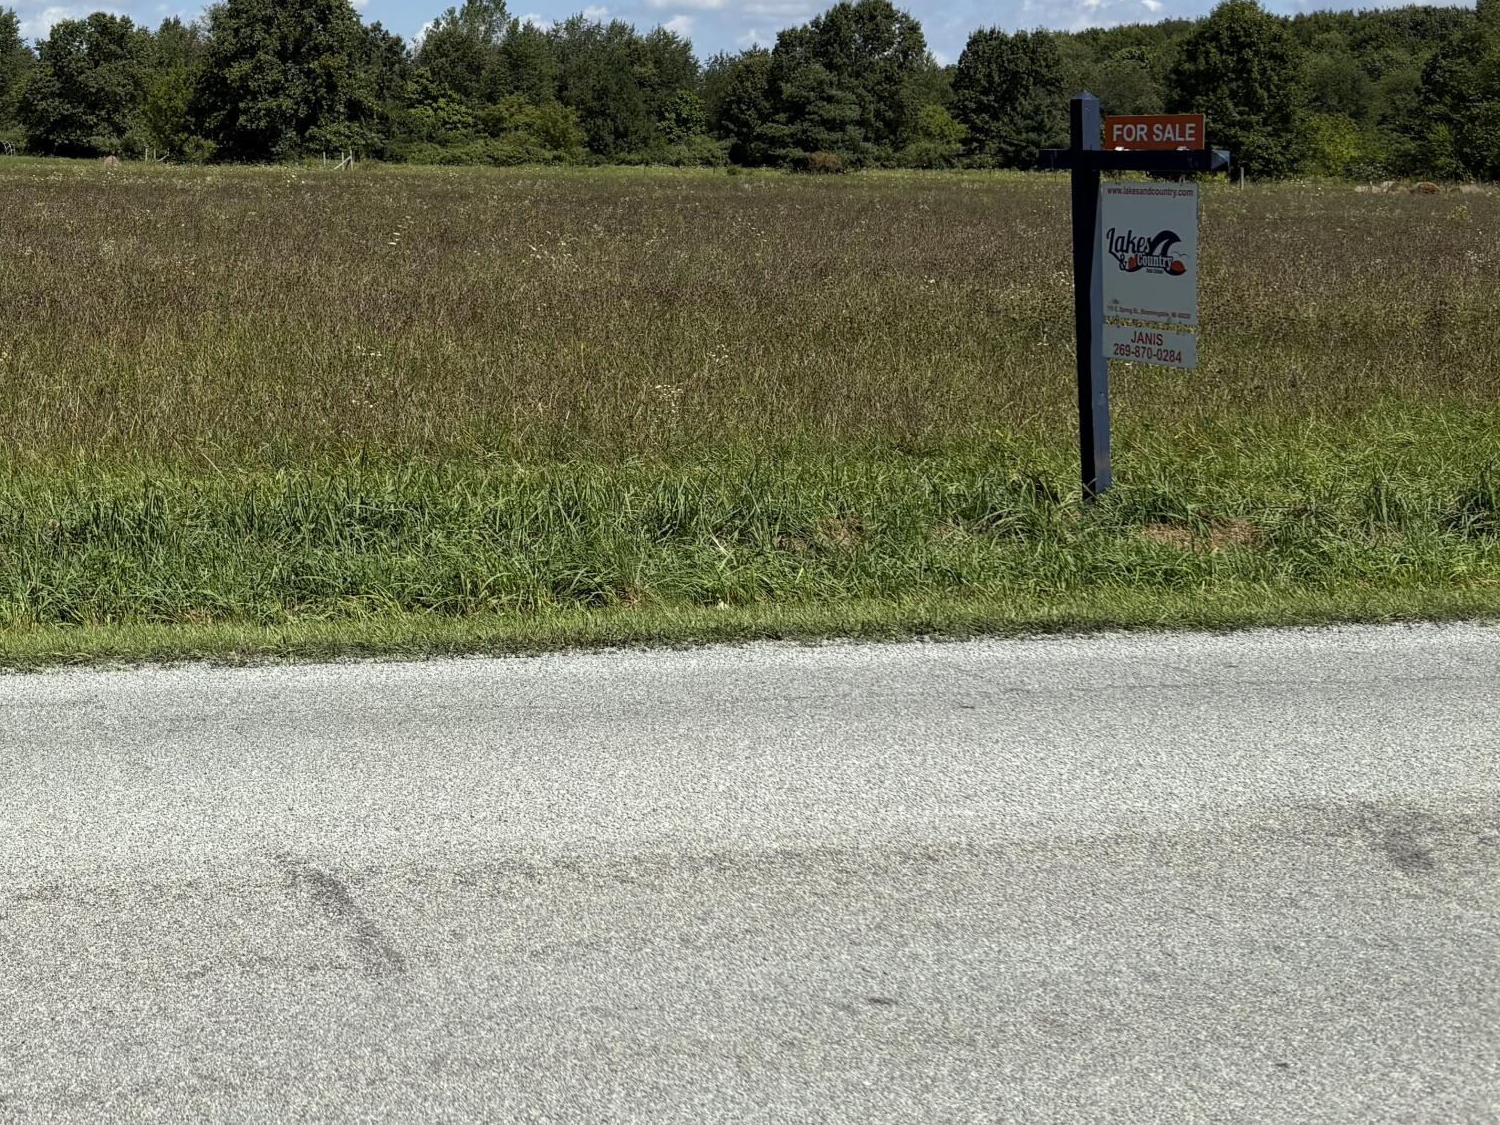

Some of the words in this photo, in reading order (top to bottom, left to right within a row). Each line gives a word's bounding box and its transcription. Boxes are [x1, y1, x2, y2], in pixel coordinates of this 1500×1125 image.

[1112, 124, 1148, 142] FOR
[1153, 123, 1196, 142] SALE
[1107, 186, 1194, 198] www.lakesandcountry.com
[1106, 227, 1152, 254] Lakes
[1137, 253, 1173, 271] Country
[1130, 331, 1164, 346] JANIS
[1113, 343, 1182, 363] 269-870-0284
